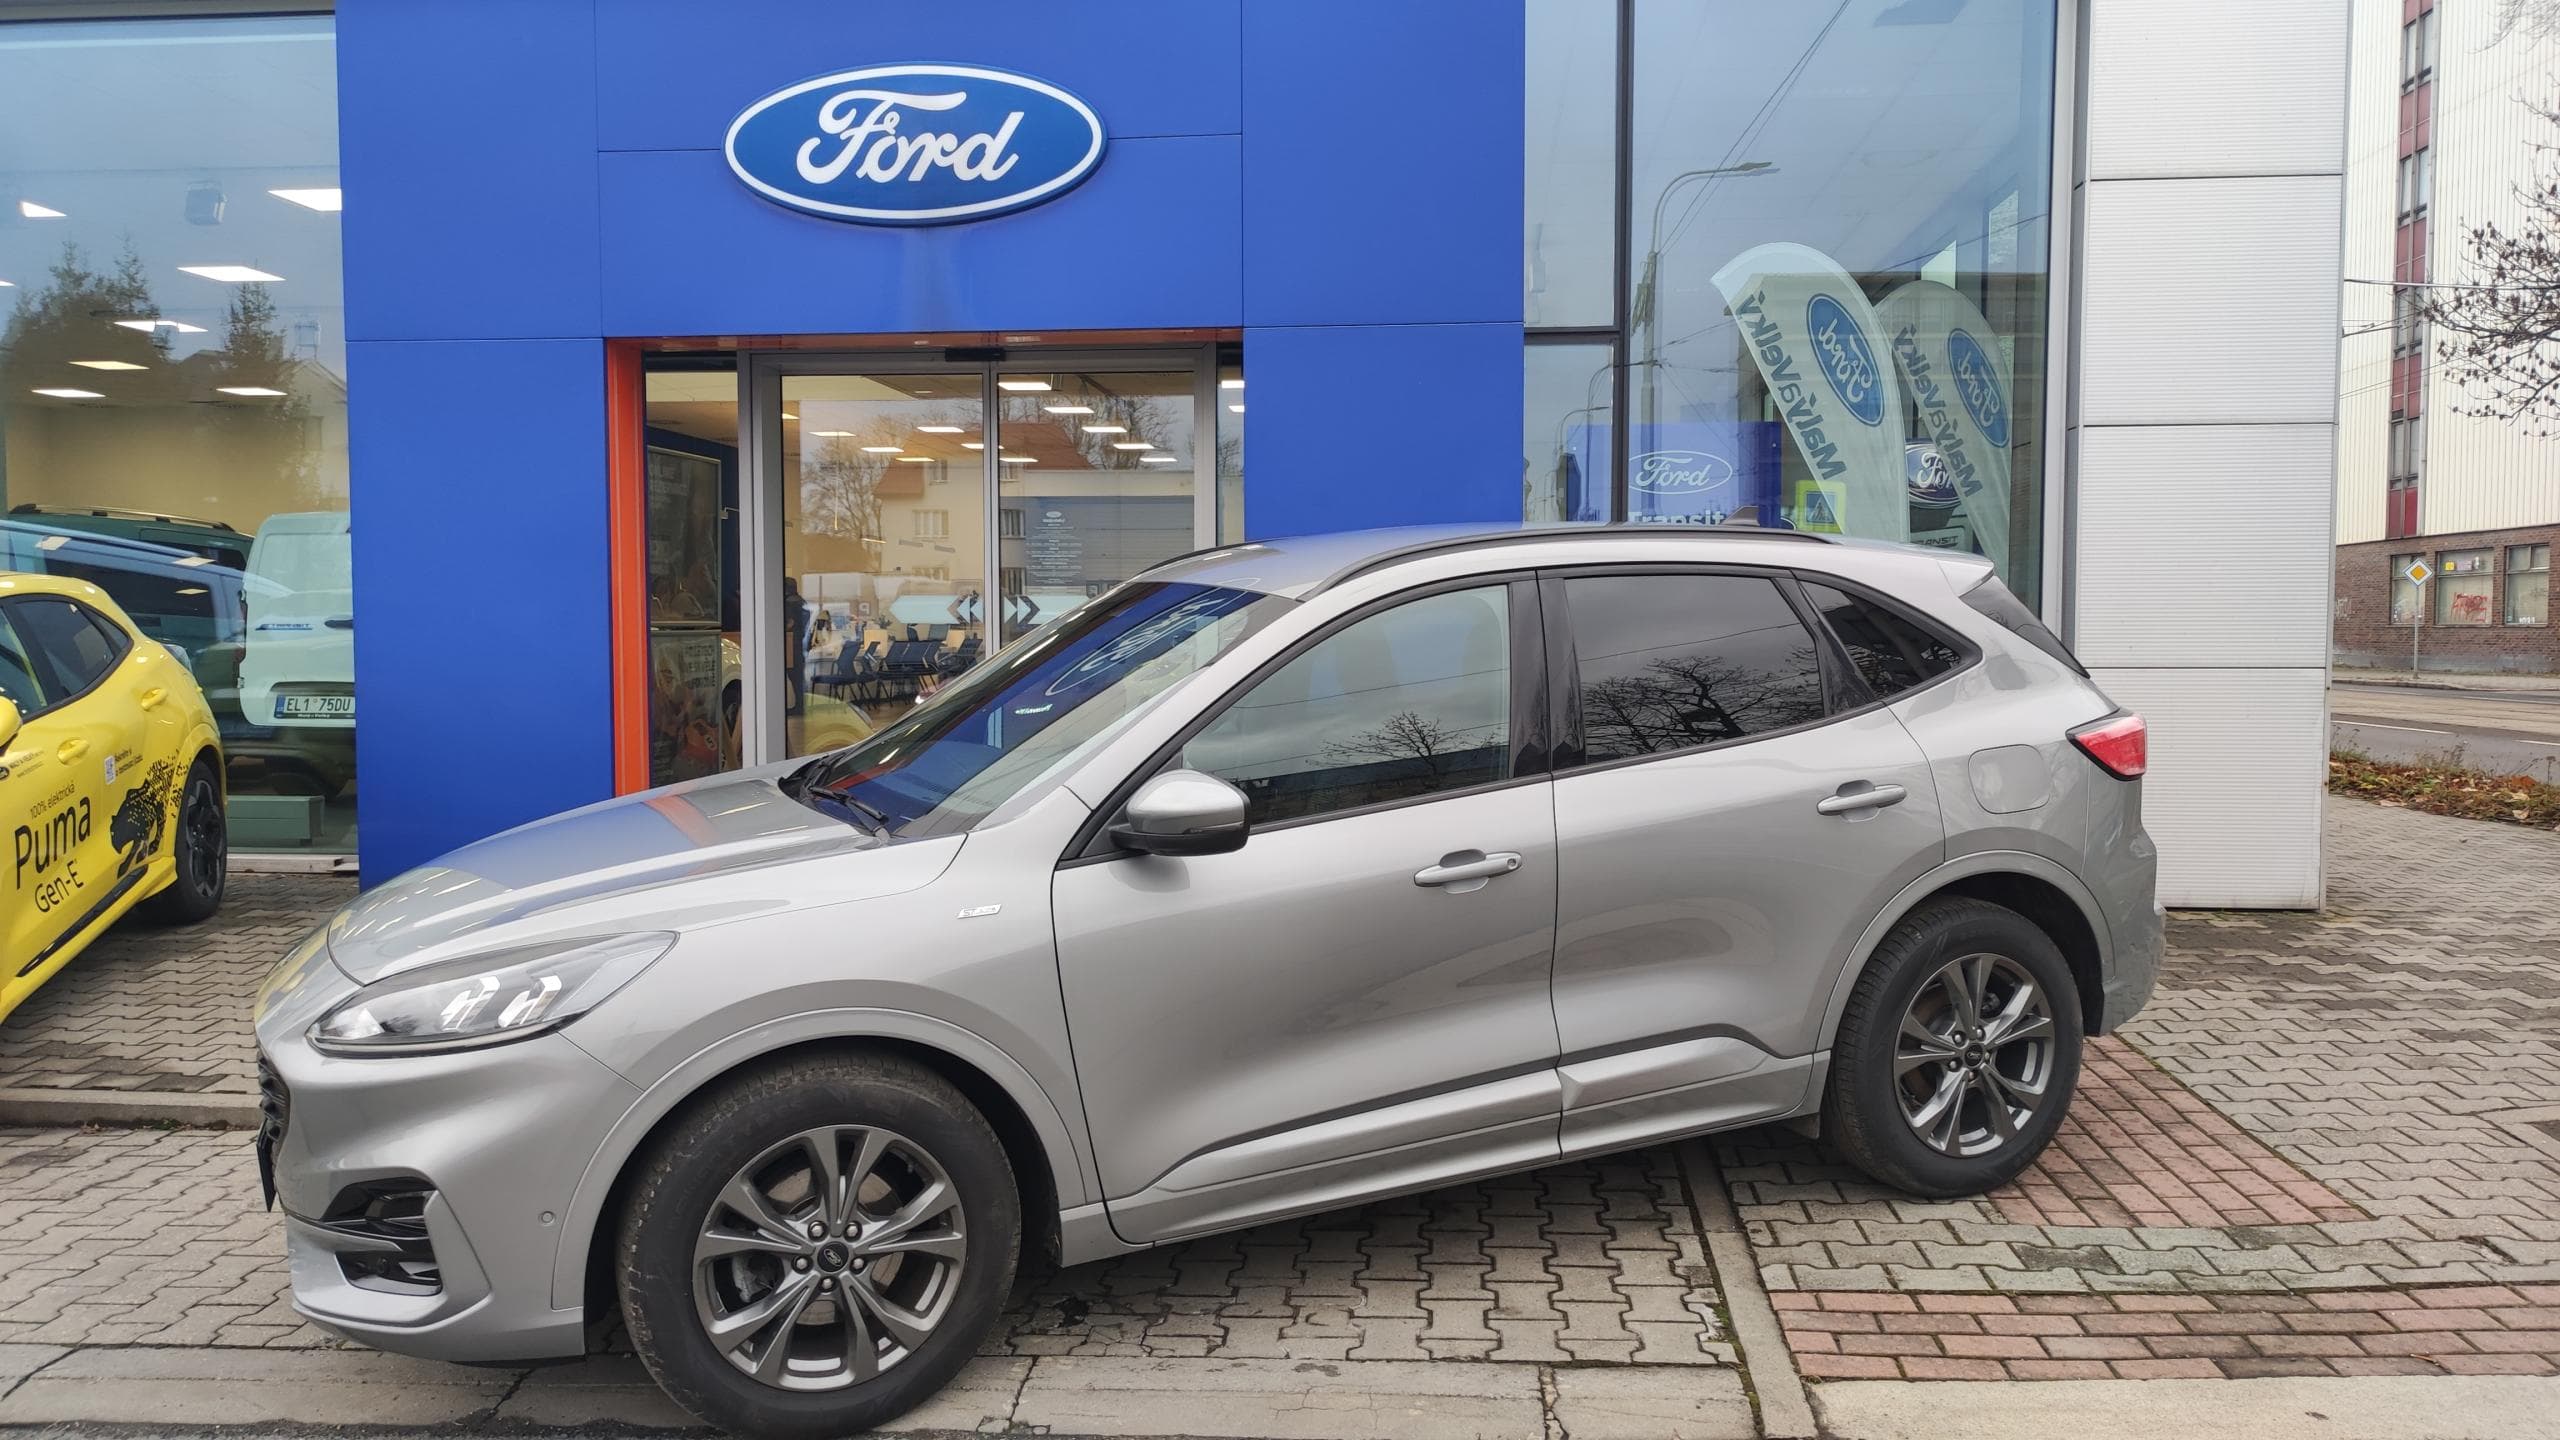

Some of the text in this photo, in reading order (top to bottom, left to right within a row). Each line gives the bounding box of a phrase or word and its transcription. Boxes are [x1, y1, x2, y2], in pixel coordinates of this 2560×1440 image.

[796, 90, 1024, 184] Ford
[1635, 456, 1712, 486] Ford
[287, 698, 351, 712] EL1 75DU
[14, 796, 91, 890] Puma
[34, 860, 84, 913] Gen-E
